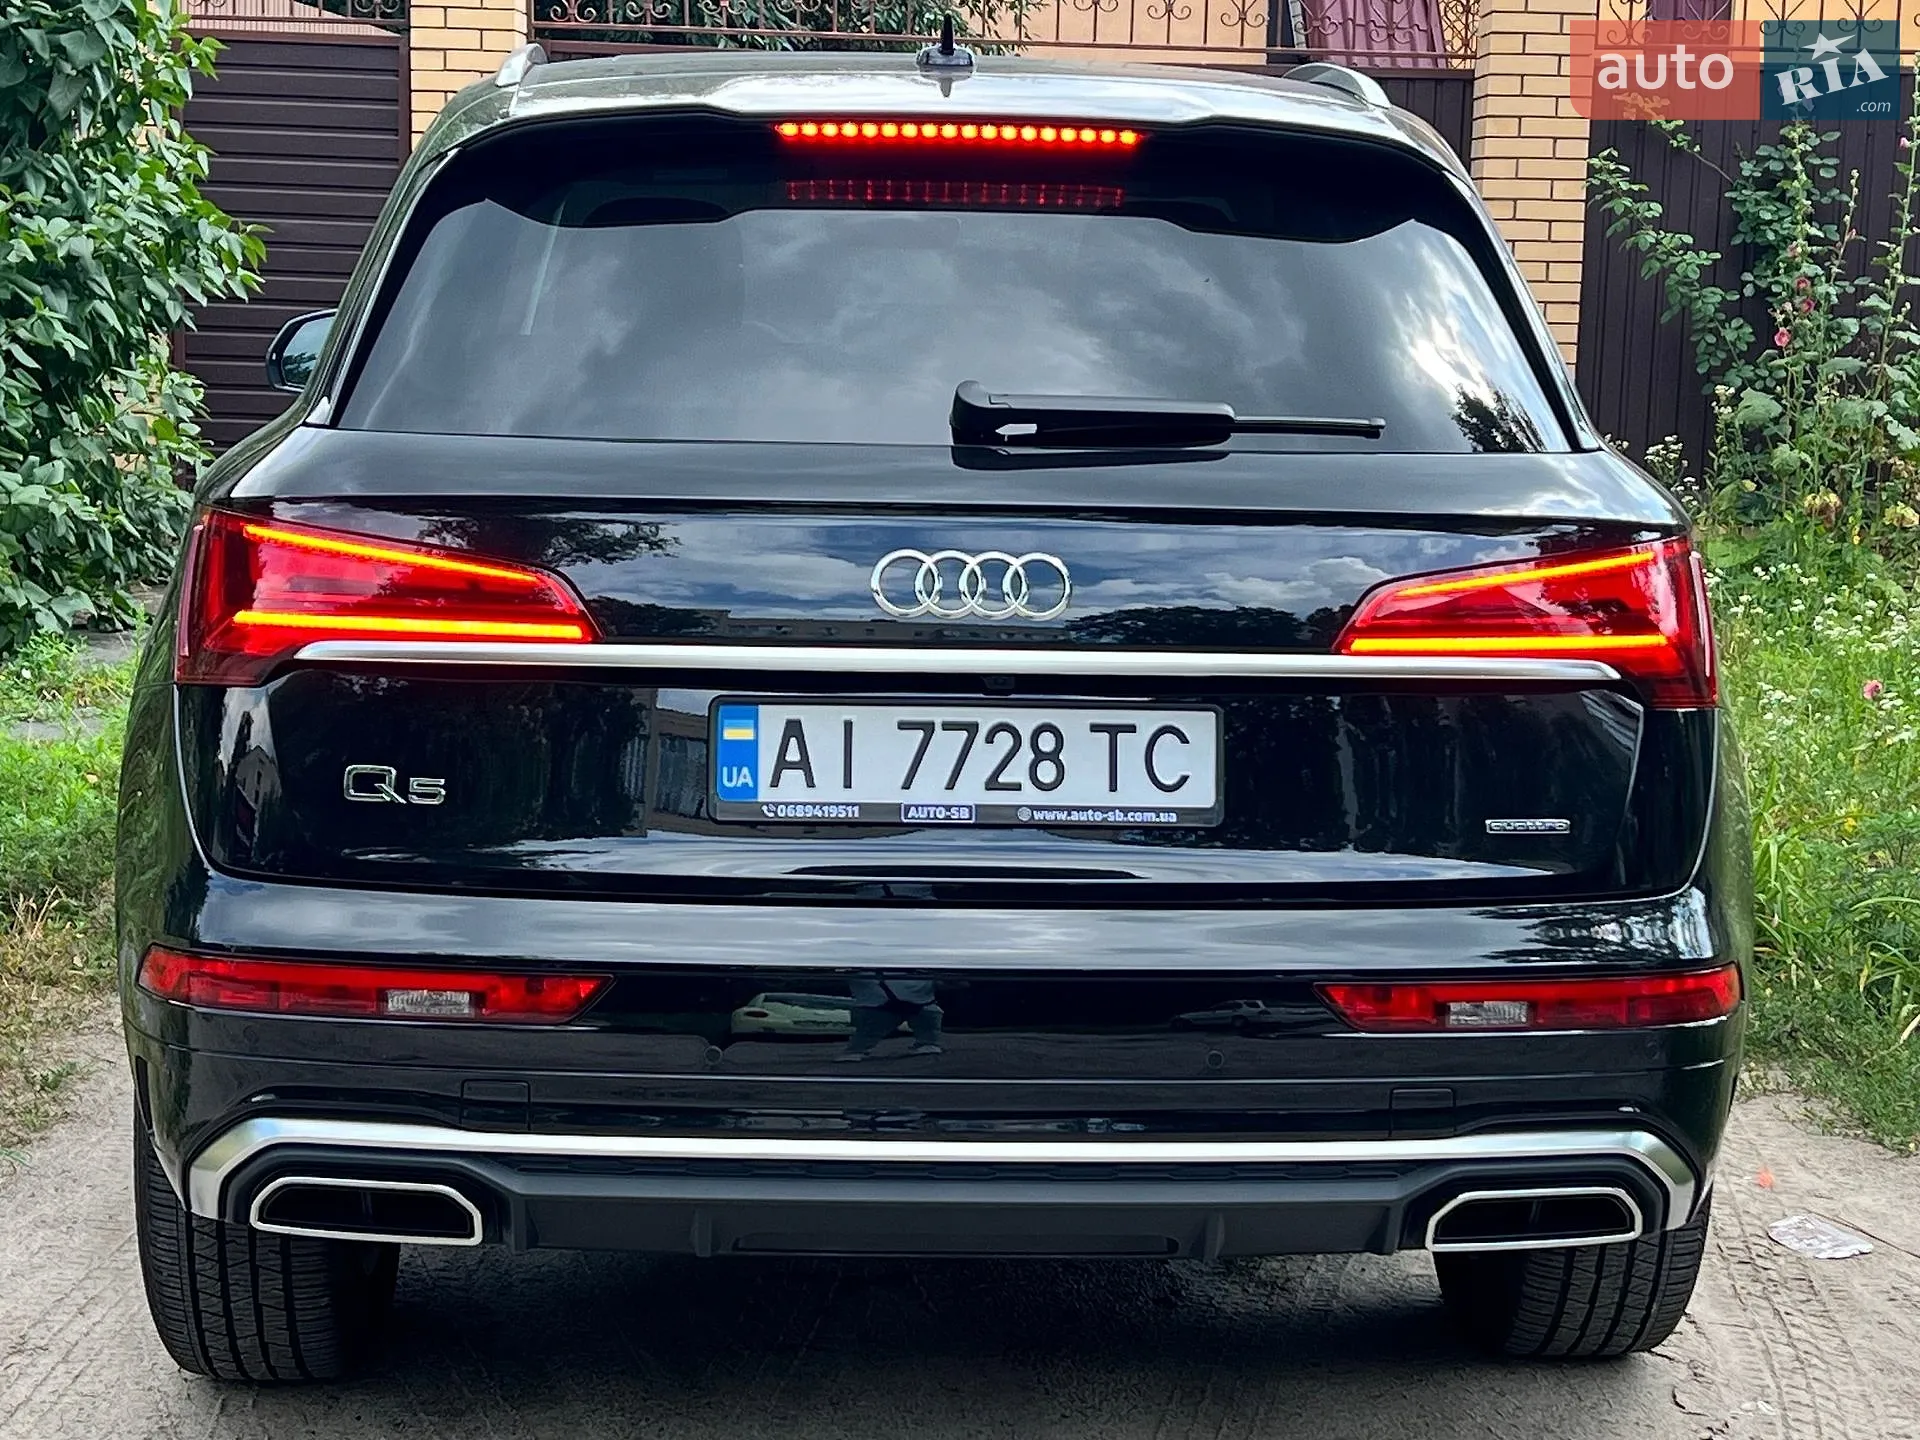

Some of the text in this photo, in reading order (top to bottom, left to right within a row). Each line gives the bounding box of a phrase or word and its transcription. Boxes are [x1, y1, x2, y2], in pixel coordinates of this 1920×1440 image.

[769, 718, 1190, 793] AI 7728 TC
[343, 764, 446, 805] Q5
[722, 766, 754, 788] UA
[777, 804, 860, 819] 0689419511
[907, 806, 970, 819] AUTO-SB
[1033, 808, 1178, 823] www.auto-sb.com.ua
